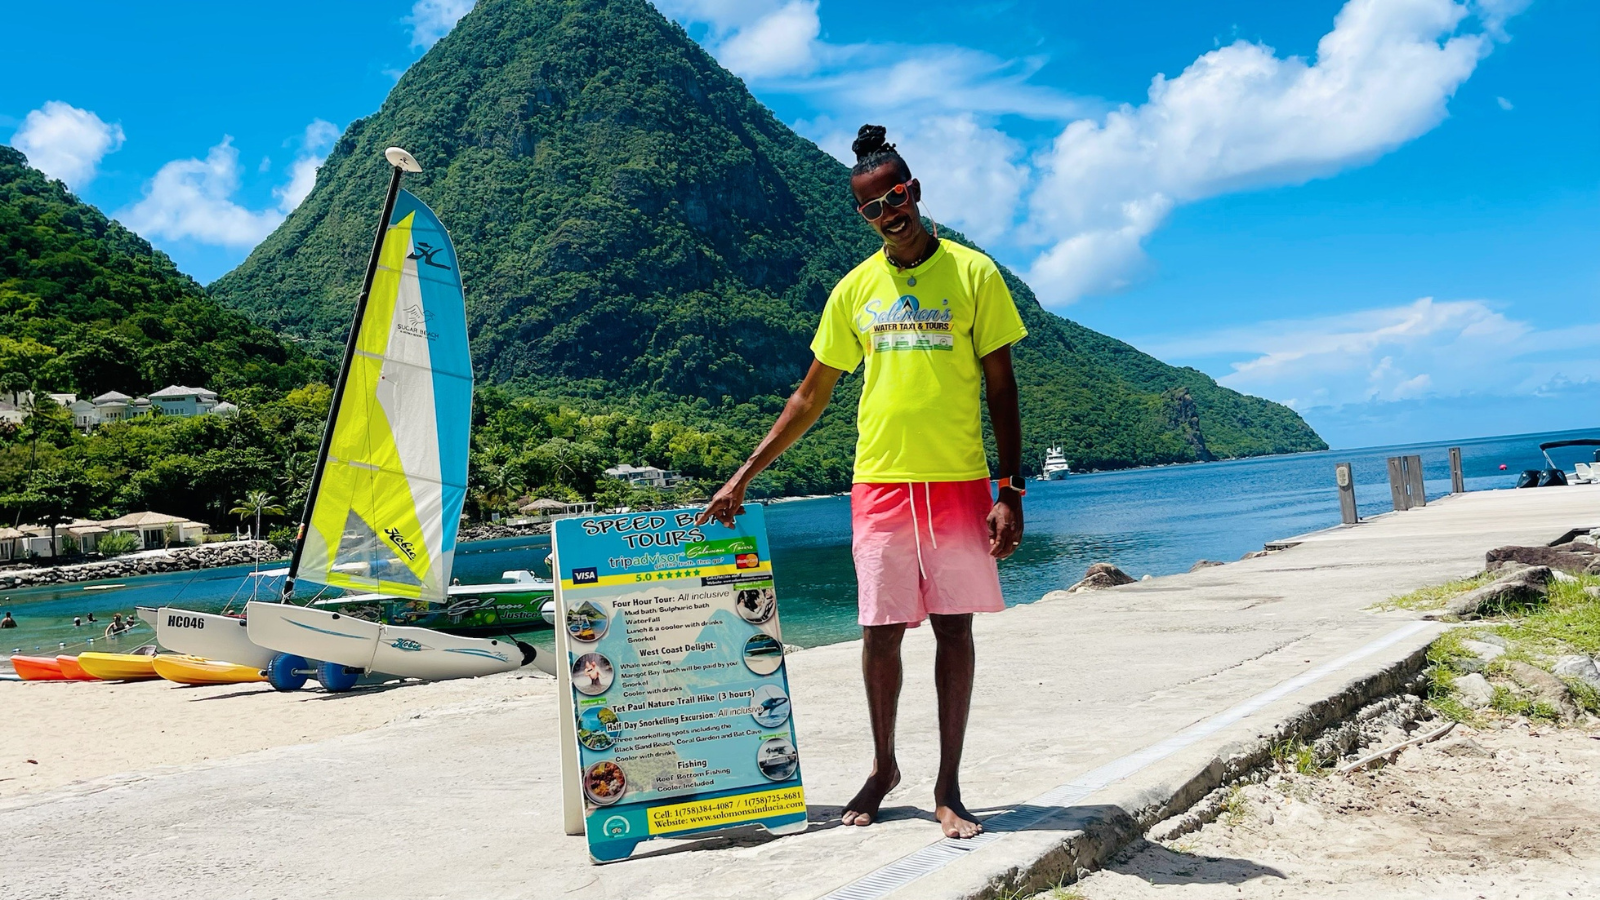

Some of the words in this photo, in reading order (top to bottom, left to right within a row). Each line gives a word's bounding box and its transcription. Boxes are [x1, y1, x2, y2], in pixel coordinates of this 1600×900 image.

[873, 323, 897, 332] WATER
[917, 322, 923, 330] &
[925, 321, 949, 330] TOURS
[582, 514, 666, 536] SPEED
[623, 527, 706, 549] TOURS
[609, 552, 681, 569] tripadvisor
[575, 571, 596, 580] VISA
[635, 573, 652, 582] 5.0
[612, 600, 631, 608] Four
[632, 598, 652, 607] Hour
[653, 596, 675, 604] Tour:
[677, 593, 690, 601] All
[691, 590, 730, 601] inclusive
[167, 615, 205, 629] HC046
[625, 616, 661, 625] Waterfall
[626, 626, 648, 635] Lunch
[660, 623, 684, 631] cooler
[701, 619, 723, 627] drinks
[627, 635, 657, 644] Snorkel
[639, 648, 659, 657] West
[661, 645, 683, 655] Coast
[685, 642, 717, 653] Delight:
[620, 662, 641, 670] Whale
[641, 660, 672, 668] watching
[621, 671, 647, 679] Marigot
[681, 664, 692, 672] will
[702, 661, 717, 670] paid
[717, 660, 725, 668] by
[622, 680, 649, 688] Snorkel
[612, 705, 625, 713] Tet
[627, 702, 646, 711] Paul
[648, 699, 675, 709] Nature
[676, 696, 696, 705] Trail
[697, 694, 715, 703] Hike
[718, 692, 727, 701] (3
[728, 688, 756, 699] hours)
[623, 690, 646, 698] Cooler
[607, 721, 622, 732] Half
[624, 720, 638, 730] Day
[639, 714, 679, 727] Snorkelling
[680, 711, 717, 722] Excursion:
[717, 708, 728, 717] All
[729, 705, 763, 715] inclusive
[633, 731, 671, 741] snorkelling
[671, 729, 690, 737] spots
[690, 724, 721, 733] including
[614, 745, 634, 753] Black
[676, 737, 695, 745] Coral
[695, 734, 720, 742] Garden
[615, 755, 638, 763] Cooler
[677, 759, 707, 769] Fishing
[676, 771, 704, 780] Bottom
[705, 768, 731, 776] Fishing
[657, 784, 682, 792] Cooler
[683, 778, 714, 788] Included
[653, 809, 673, 819] Cell:
[675, 801, 734, 818] 1(758)384-4087
[744, 791, 801, 808] 1(758)725-8681
[654, 818, 689, 829] Website:
[690, 800, 804, 824] www.solomonsaintlucia.com
